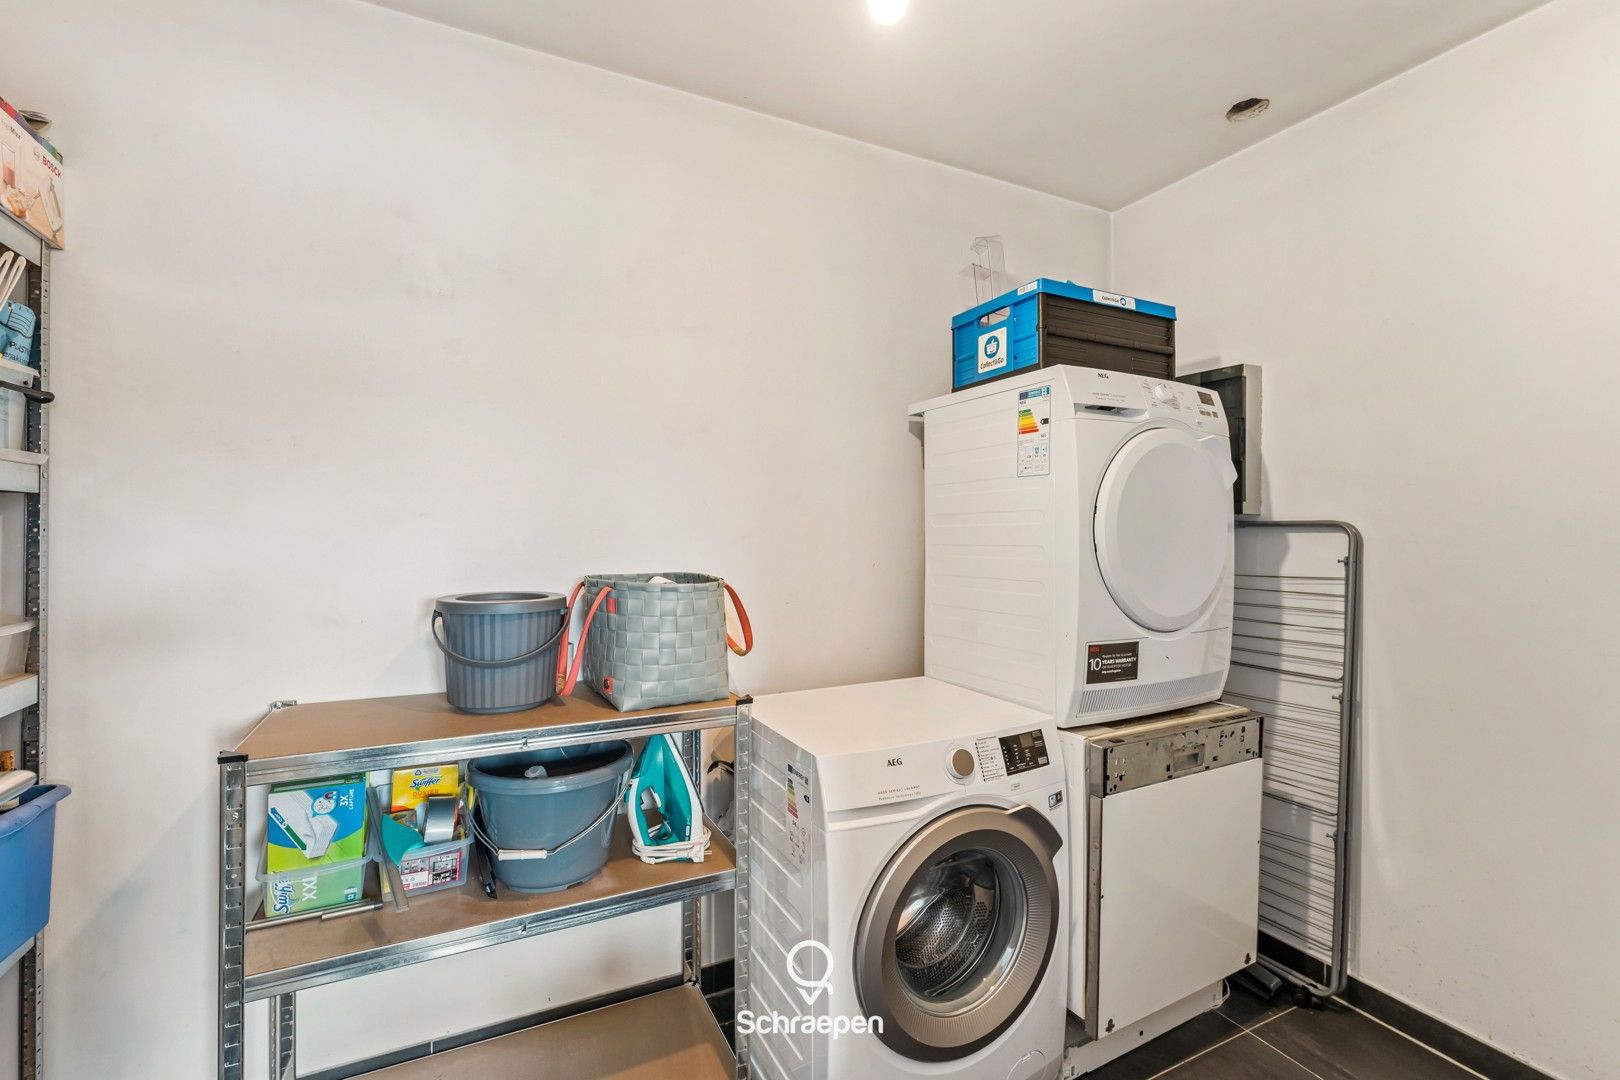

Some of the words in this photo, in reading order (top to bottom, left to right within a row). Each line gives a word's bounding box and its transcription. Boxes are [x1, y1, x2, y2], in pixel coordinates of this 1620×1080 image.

[42, 155, 62, 178] BOSCH
[1089, 658, 1101, 670] 10
[887, 758, 902, 766] AEG
[410, 777, 440, 788] Swiffer
[340, 795, 349, 806] 3X
